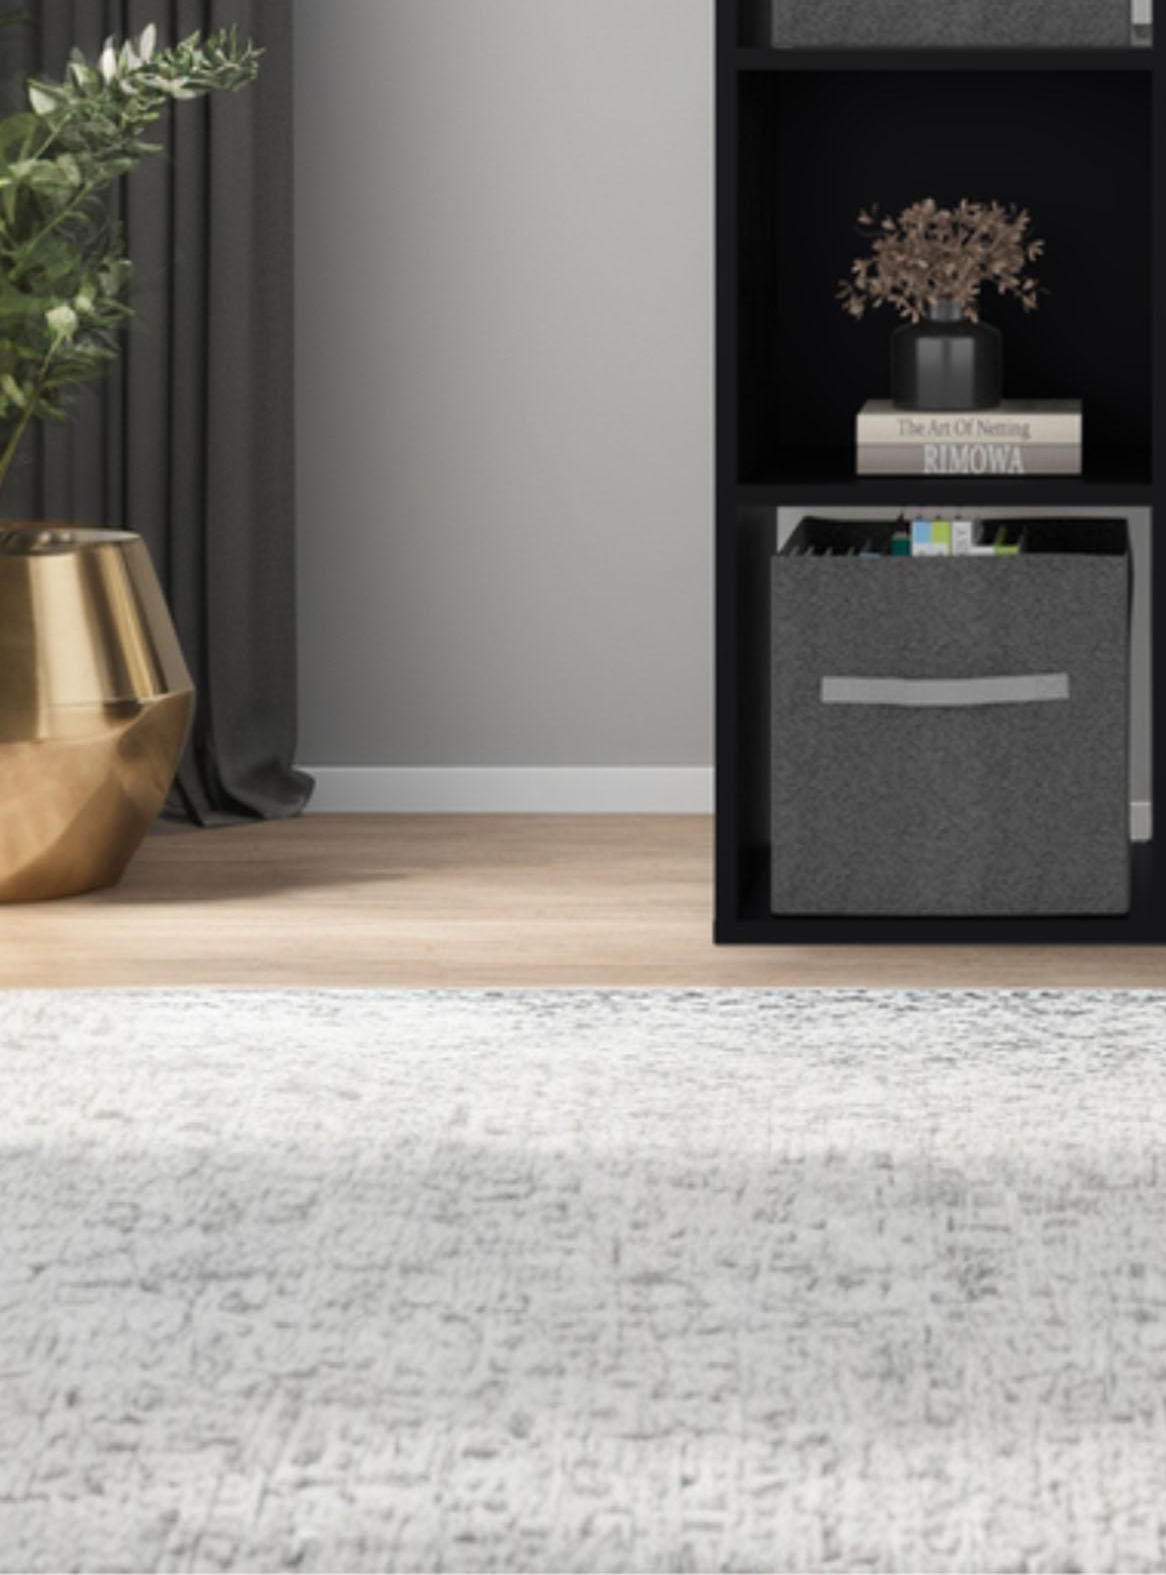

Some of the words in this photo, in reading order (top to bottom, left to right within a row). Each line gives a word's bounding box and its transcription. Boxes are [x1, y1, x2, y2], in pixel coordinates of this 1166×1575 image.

[897, 418, 924, 437] The
[927, 418, 951, 437] Art
[954, 417, 975, 437] Of
[922, 444, 1025, 475] RIMOWA
